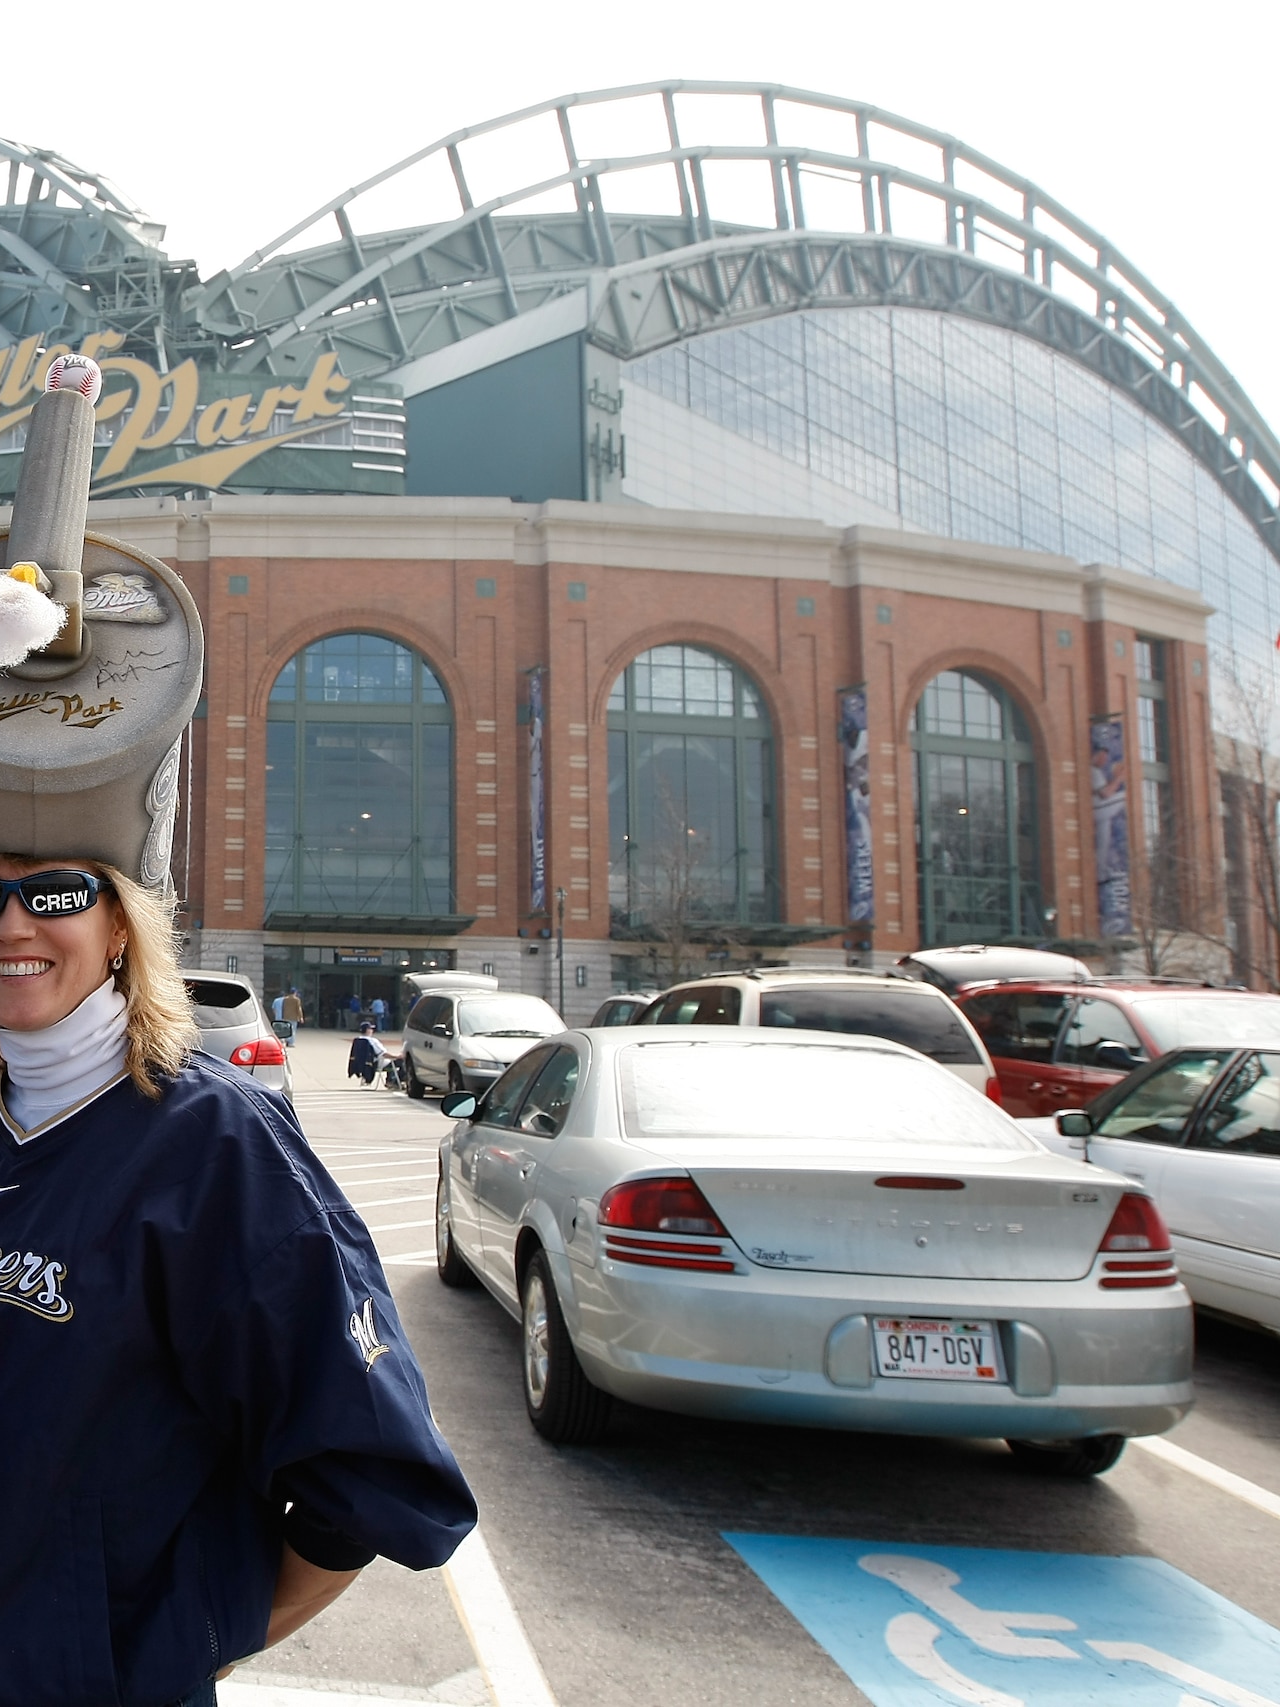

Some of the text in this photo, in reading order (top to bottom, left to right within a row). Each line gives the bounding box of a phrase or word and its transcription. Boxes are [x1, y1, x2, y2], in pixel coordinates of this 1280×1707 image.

[91, 351, 352, 481] Park
[38, 692, 125, 729] Park
[32, 889, 89, 912] CREW
[887, 1334, 984, 1366] 847-DGV
